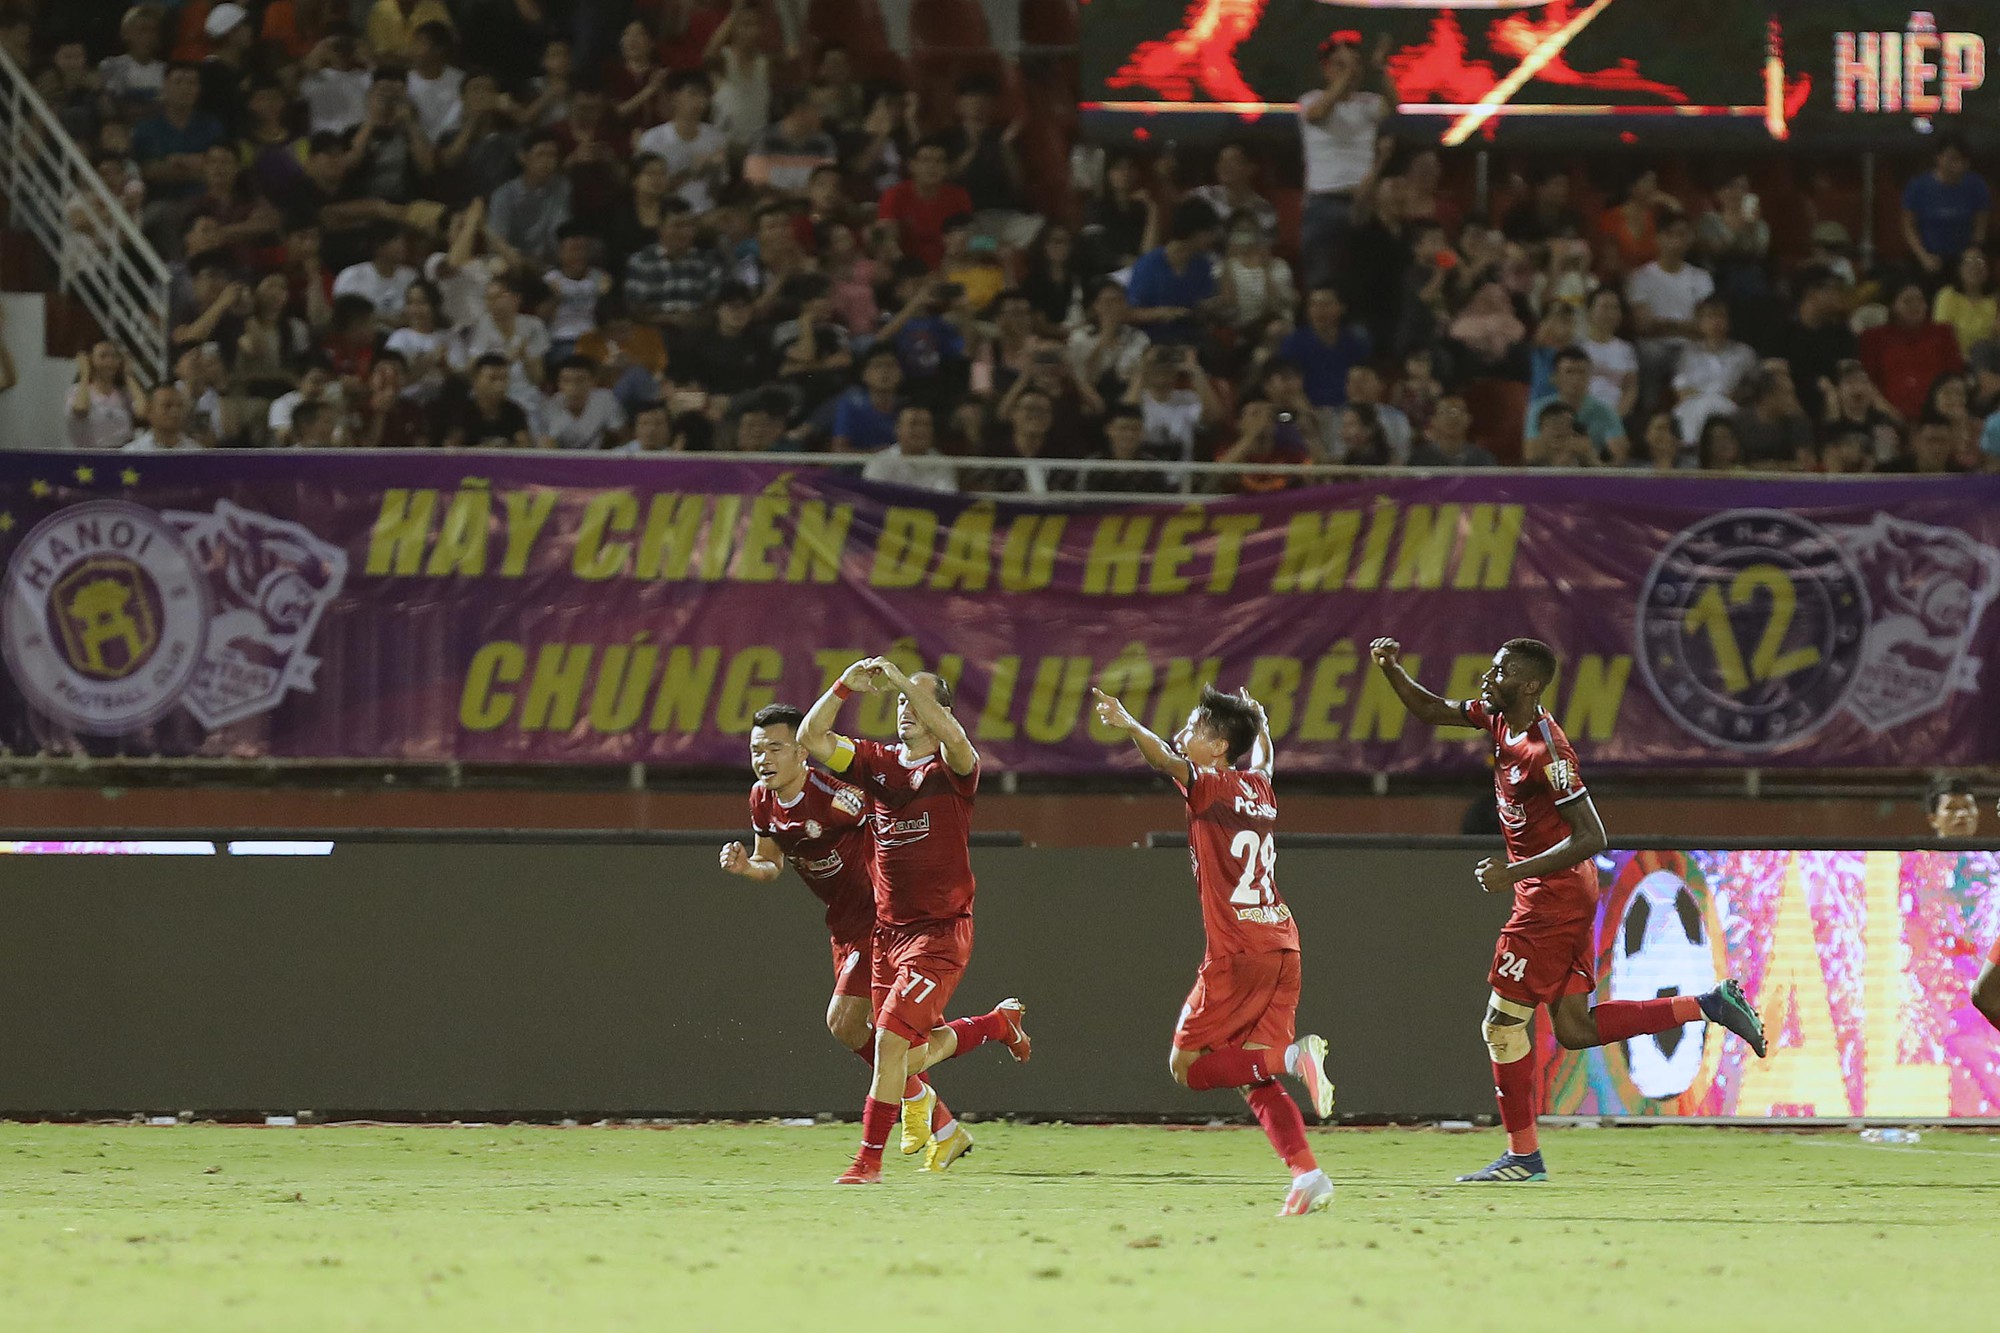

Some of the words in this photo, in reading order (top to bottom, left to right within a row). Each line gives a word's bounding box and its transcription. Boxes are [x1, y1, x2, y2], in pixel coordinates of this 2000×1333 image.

[22, 518, 153, 592] HANOI
[365, 476, 559, 577] HÃY
[572, 472, 853, 583] CHIẾN
[1271, 494, 1525, 592] MÌNH
[1684, 563, 1821, 692] 12
[460, 630, 783, 734] CHÚNG
[1435, 654, 1633, 742] BN
[900, 969, 937, 1004] 77
[1497, 951, 1528, 982] 24
